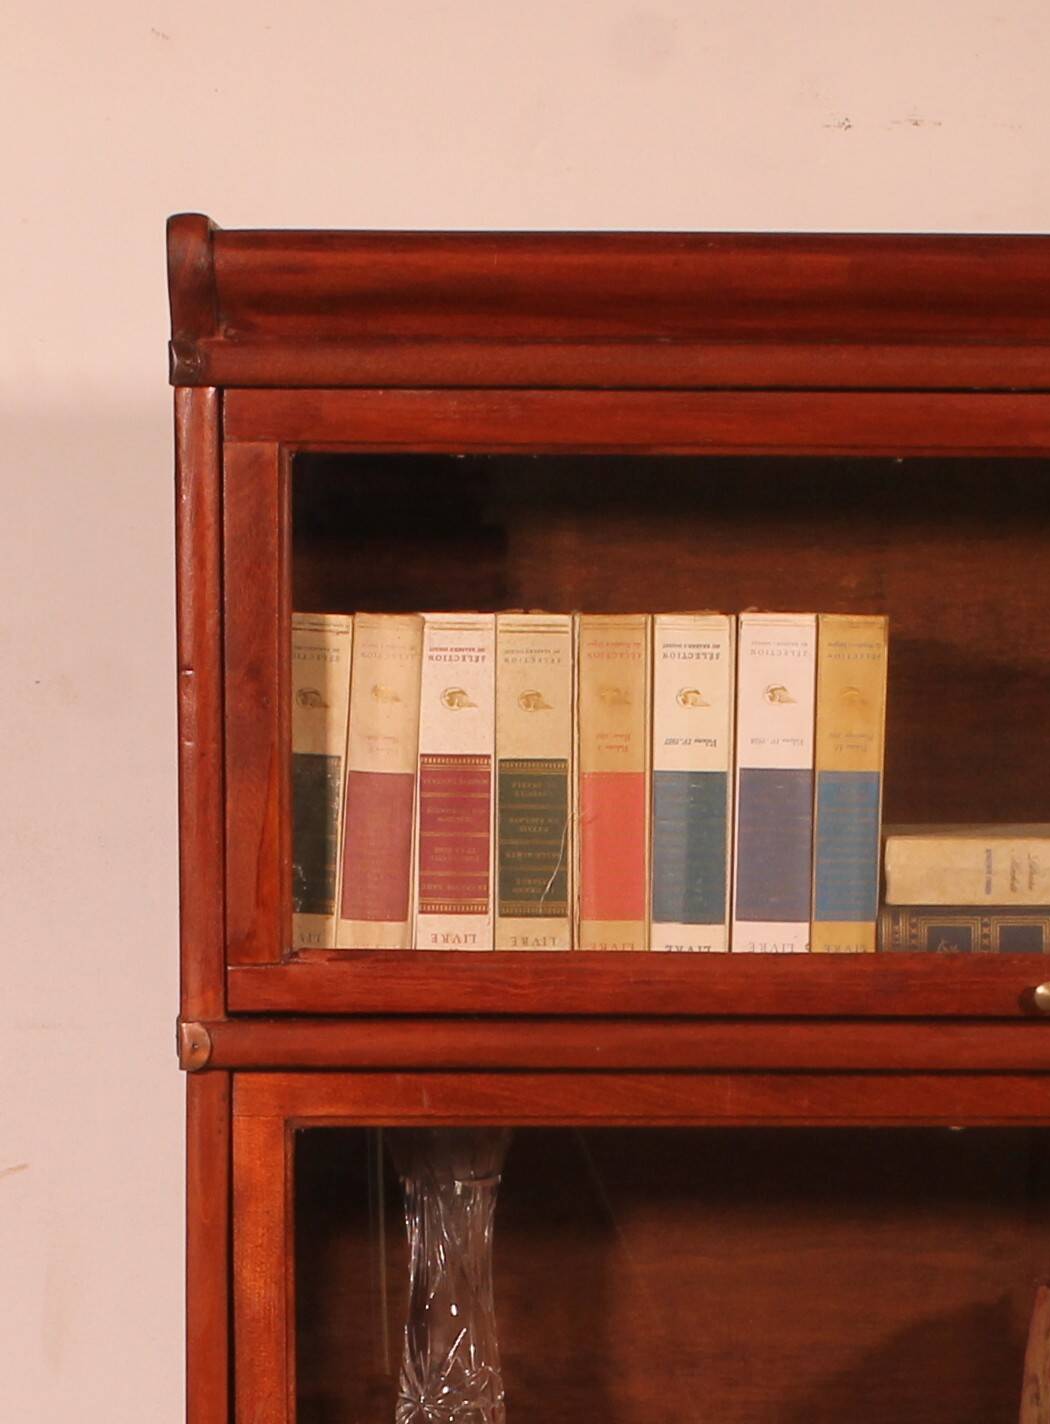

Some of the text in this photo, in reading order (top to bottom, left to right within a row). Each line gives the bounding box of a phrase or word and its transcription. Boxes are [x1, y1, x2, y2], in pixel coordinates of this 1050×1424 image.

[428, 653, 486, 664] SÉLECTION
[663, 650, 720, 661] SÉLECTION
[430, 932, 477, 945] LIVRE
[509, 935, 557, 948] LIVRE
